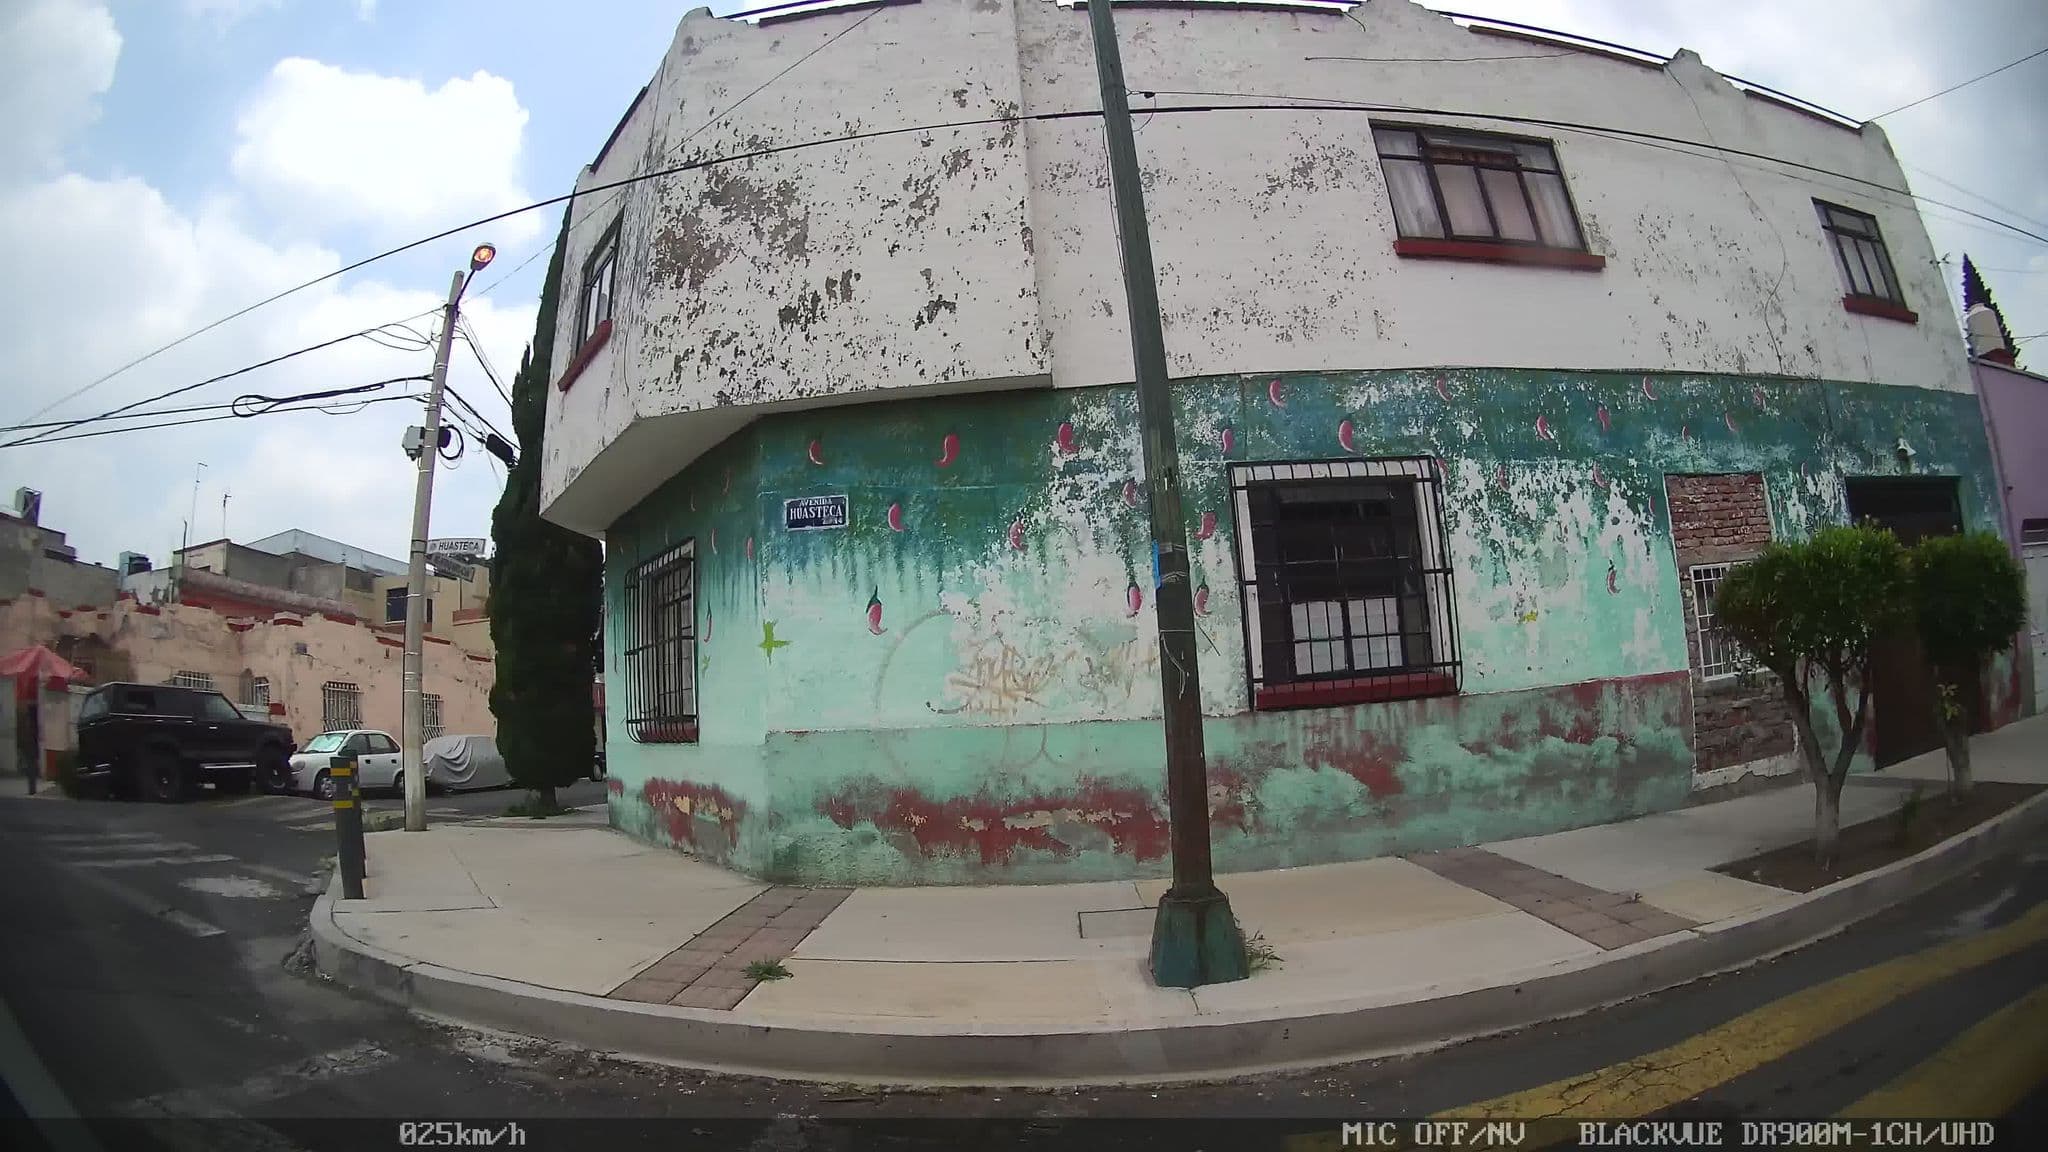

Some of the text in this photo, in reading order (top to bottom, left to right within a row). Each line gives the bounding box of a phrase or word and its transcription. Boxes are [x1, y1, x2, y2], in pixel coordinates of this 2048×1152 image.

[799, 498, 833, 507] AVENIDA
[790, 505, 843, 520] HUASTECA
[438, 541, 479, 551] HUASTECA
